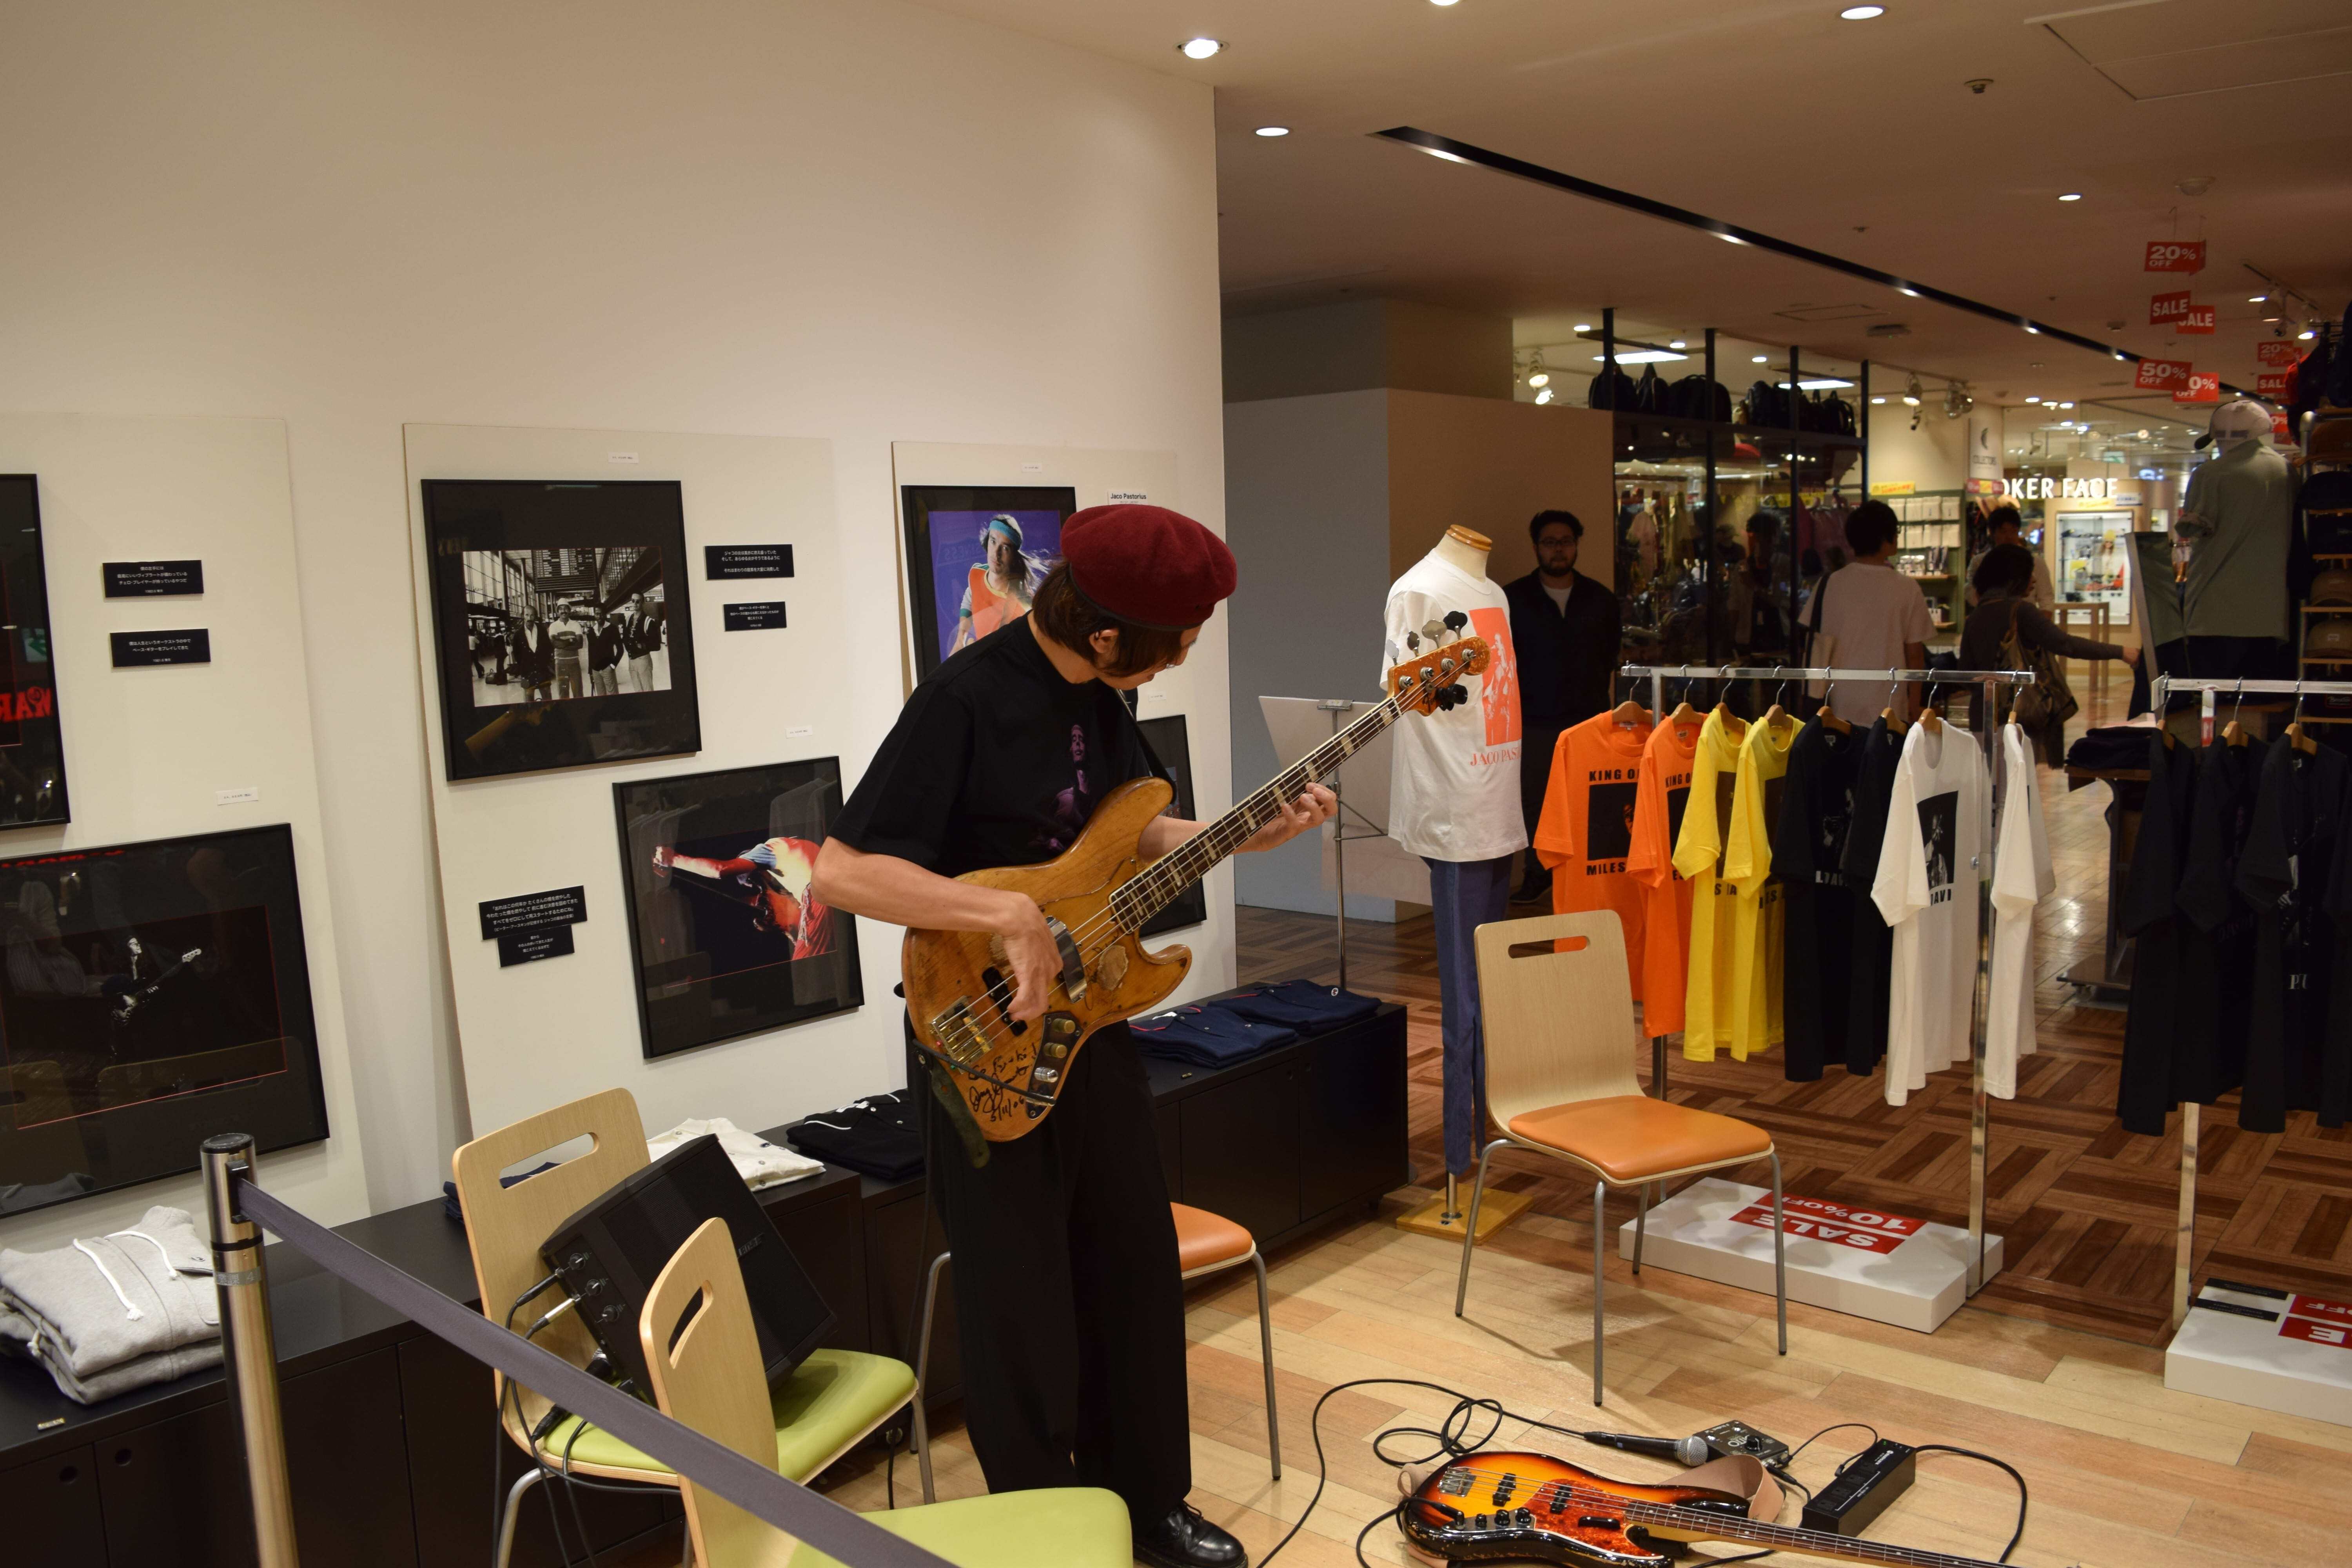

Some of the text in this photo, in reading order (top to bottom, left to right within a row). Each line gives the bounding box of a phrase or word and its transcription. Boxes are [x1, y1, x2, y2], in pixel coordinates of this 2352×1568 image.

[2150, 245, 2196, 260] 20%
[2152, 299, 2188, 316] SALE
[2141, 363, 2186, 379] 50%
[2189, 376, 2215, 390] 0%
[2259, 379, 2286, 389] SAL
[2063, 477, 2118, 499] FACE
[1470, 750, 1499, 766] JACO
[1589, 768, 1639, 782] KING O
[1665, 773, 1682, 788] KING
[1586, 862, 1626, 876] MILES
[1753, 1213, 1878, 1246] SALE
